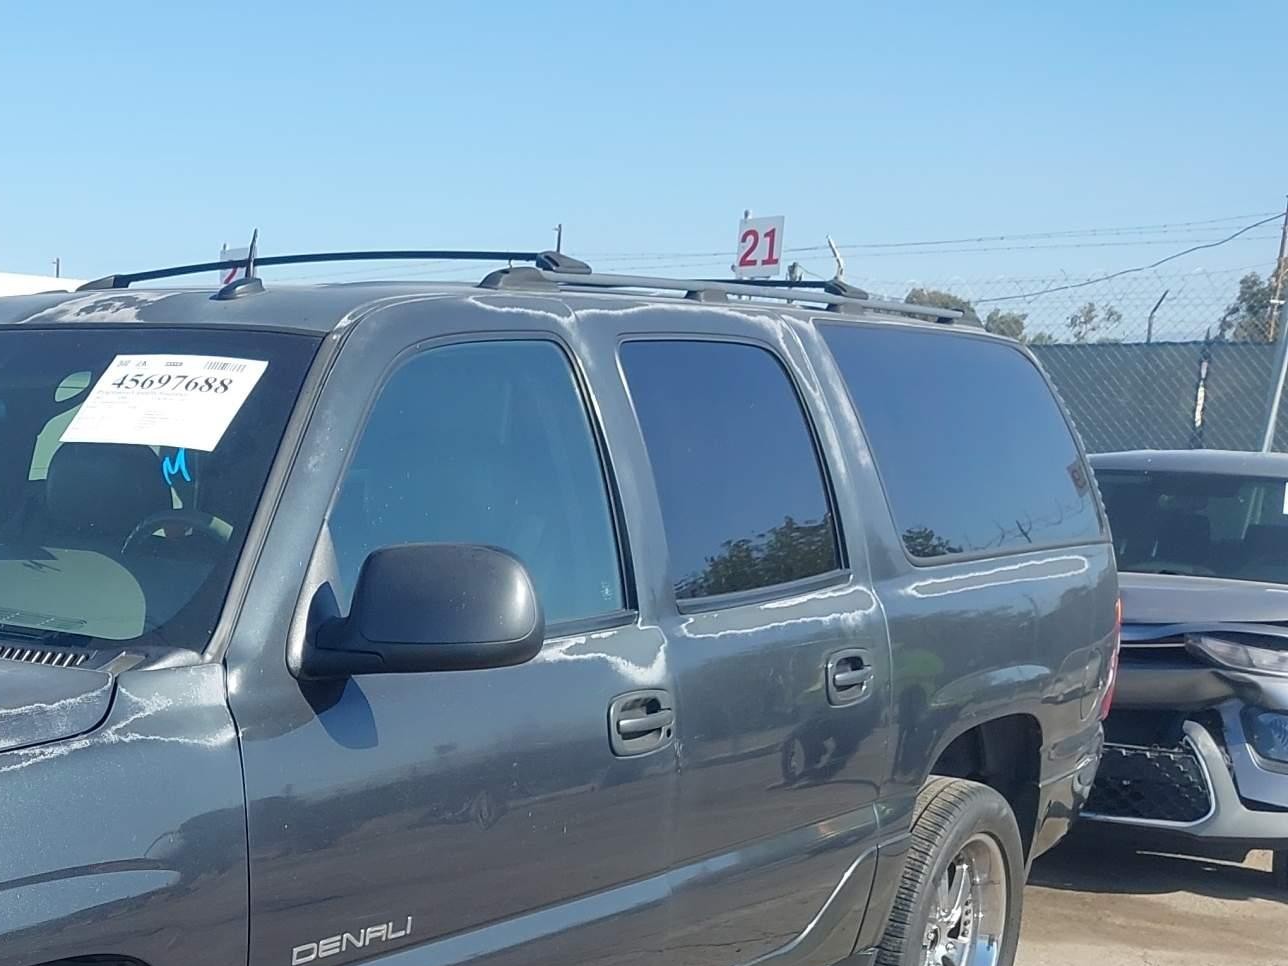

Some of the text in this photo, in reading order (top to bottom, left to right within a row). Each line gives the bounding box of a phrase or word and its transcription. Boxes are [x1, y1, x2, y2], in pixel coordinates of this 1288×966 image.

[738, 228, 779, 267] 21
[112, 372, 233, 394] 45697688
[292, 916, 412, 966] DENALI
